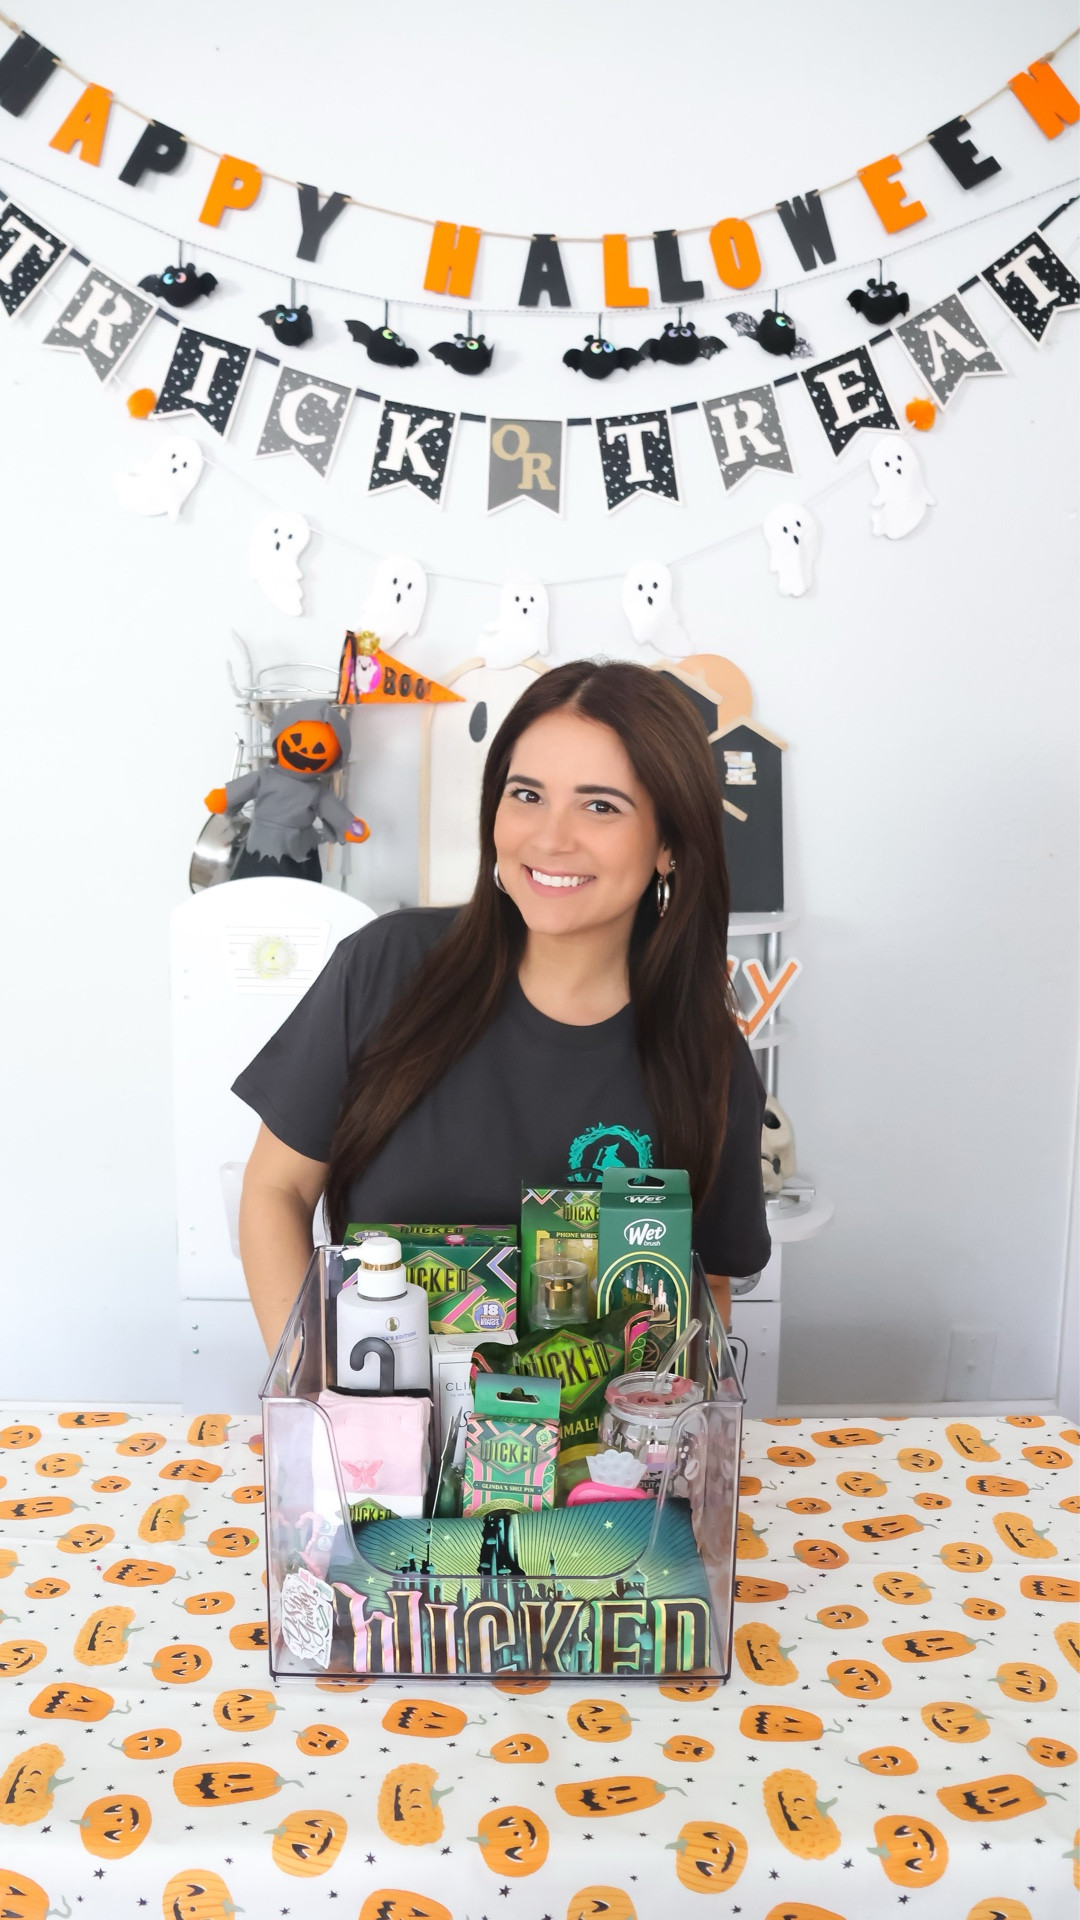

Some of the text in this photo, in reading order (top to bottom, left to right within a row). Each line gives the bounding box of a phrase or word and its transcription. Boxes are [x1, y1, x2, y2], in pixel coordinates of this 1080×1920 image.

[0, 30, 1080, 308] HAPPY HALLOWEEN
[0, 215, 1061, 491] TRICK OR TREAT
[628, 1223, 663, 1246] Wet
[406, 1267, 468, 1293] ICKED
[482, 1304, 499, 1316] 18
[480, 1440, 539, 1464] WICKED
[481, 1483, 509, 1491] GLINDA'S
[332, 1582, 711, 1674] WICKED
